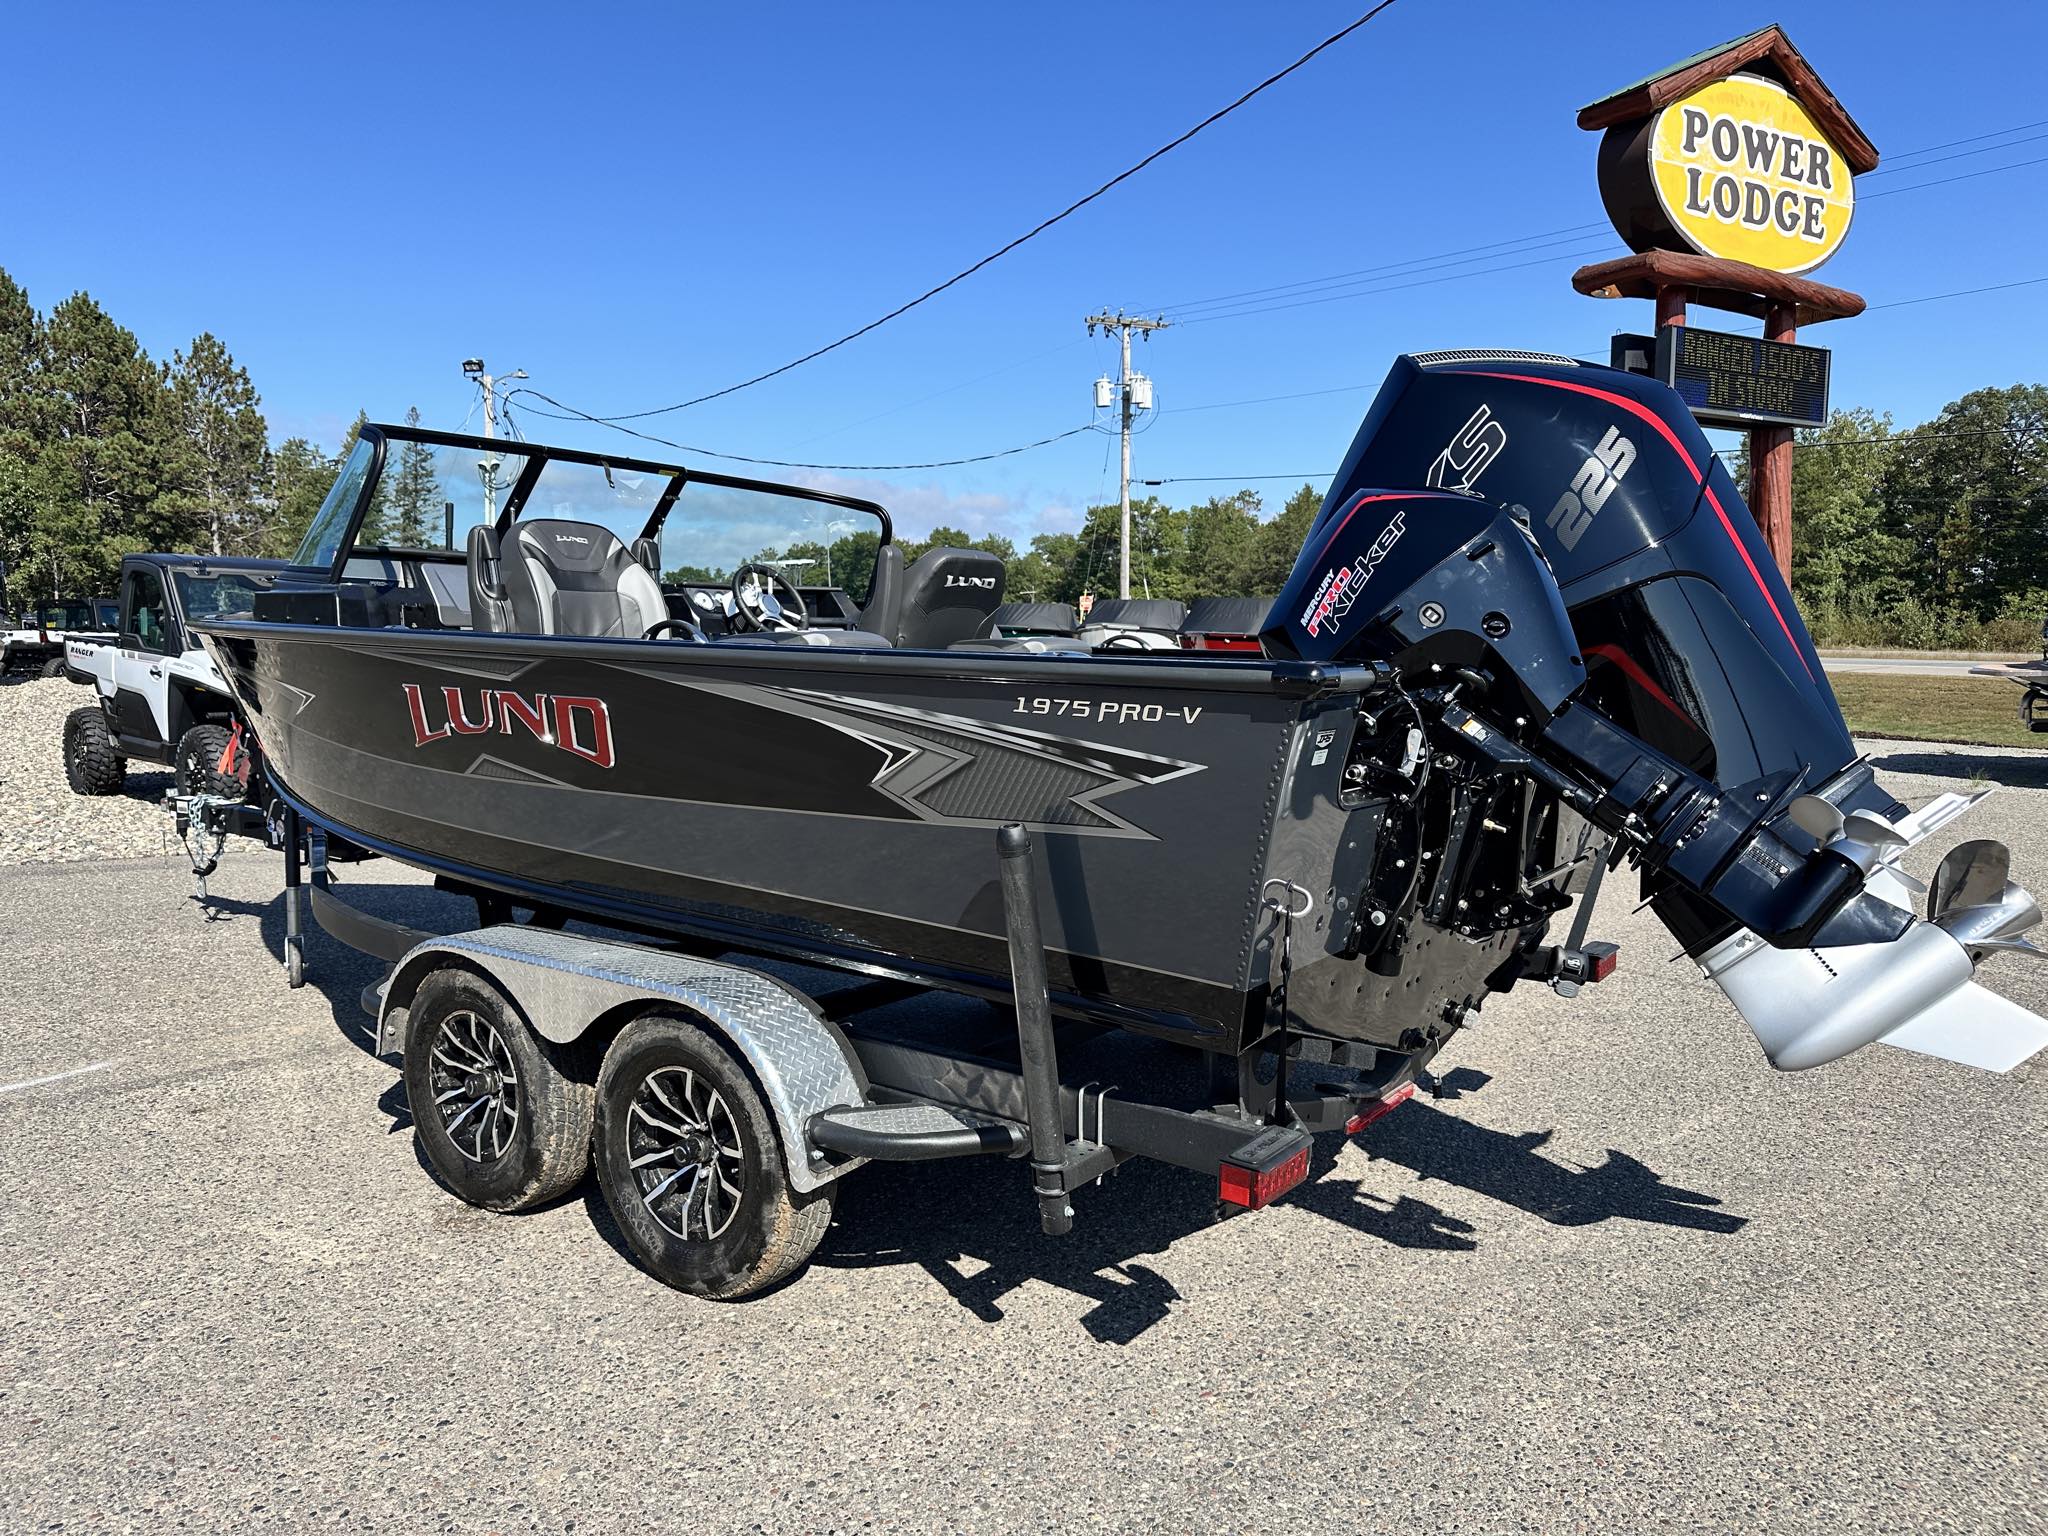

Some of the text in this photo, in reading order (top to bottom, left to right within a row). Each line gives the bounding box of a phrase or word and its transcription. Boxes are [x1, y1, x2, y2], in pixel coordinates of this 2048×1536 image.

[1683, 108, 1831, 190] POWER
[1686, 167, 1825, 240] LODGE
[1683, 332, 1754, 374] RANGER
[1707, 371, 1730, 405] IN
[1545, 424, 1638, 553] 225
[555, 534, 589, 545] LUND
[943, 574, 996, 590] LUND
[1300, 568, 1336, 628] MERCURY
[1306, 566, 1352, 638] PRO
[70, 646, 95, 658] RANGER
[401, 683, 616, 769] LUND
[1012, 696, 1203, 725] 1975 PRO-V
